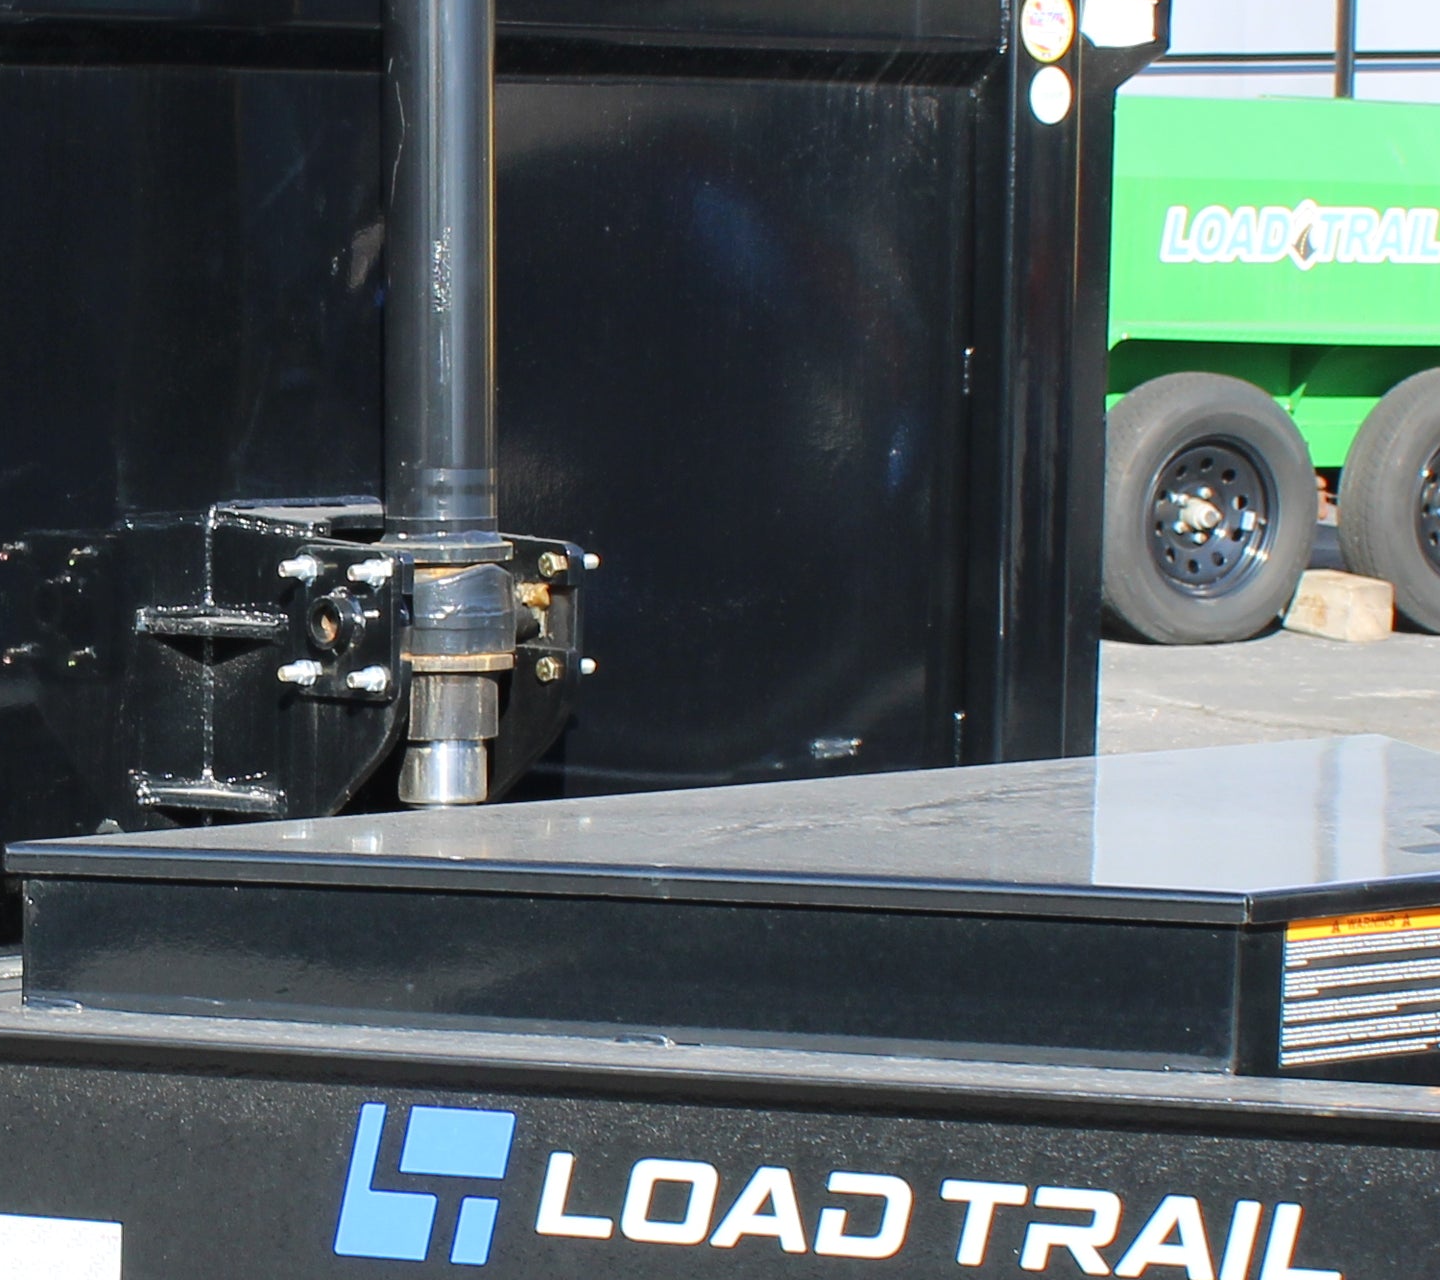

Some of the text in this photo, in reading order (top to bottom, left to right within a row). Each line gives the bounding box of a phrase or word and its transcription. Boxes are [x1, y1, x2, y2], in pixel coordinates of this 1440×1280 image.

[1161, 206, 1292, 262] LOAD
[1346, 914, 1396, 929] WARNING
[534, 1150, 914, 1260] LOAD
